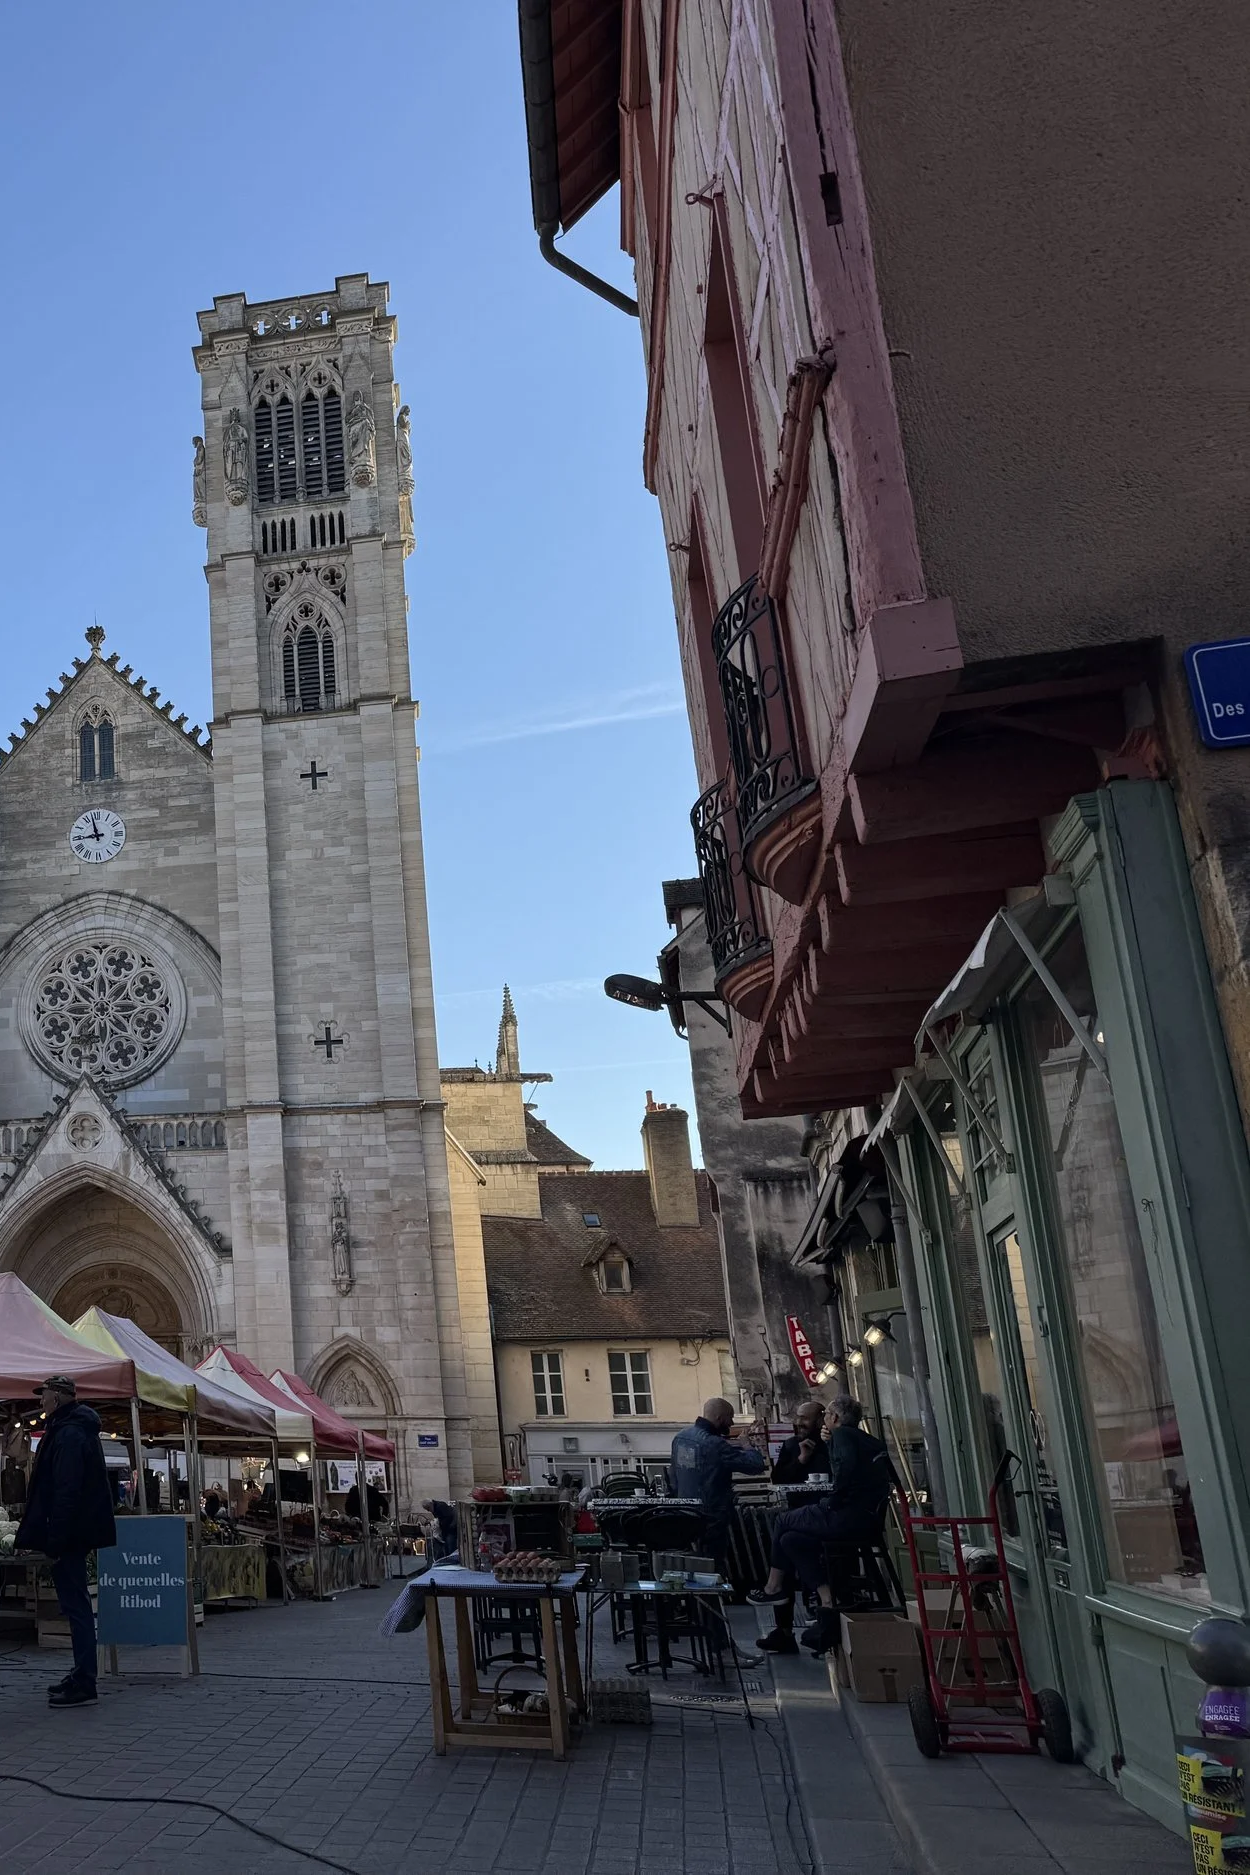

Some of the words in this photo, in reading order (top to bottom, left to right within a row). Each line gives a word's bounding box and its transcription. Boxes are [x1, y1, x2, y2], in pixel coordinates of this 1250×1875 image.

[1212, 702, 1245, 718] Des
[122, 1552, 161, 1565] Vente
[99, 1572, 116, 1587] de
[118, 1572, 185, 1590] quenelles
[120, 1594, 161, 1609] Ribod
[1193, 1831, 1208, 1845] CECI
[1195, 1852, 1210, 1865] PAS
